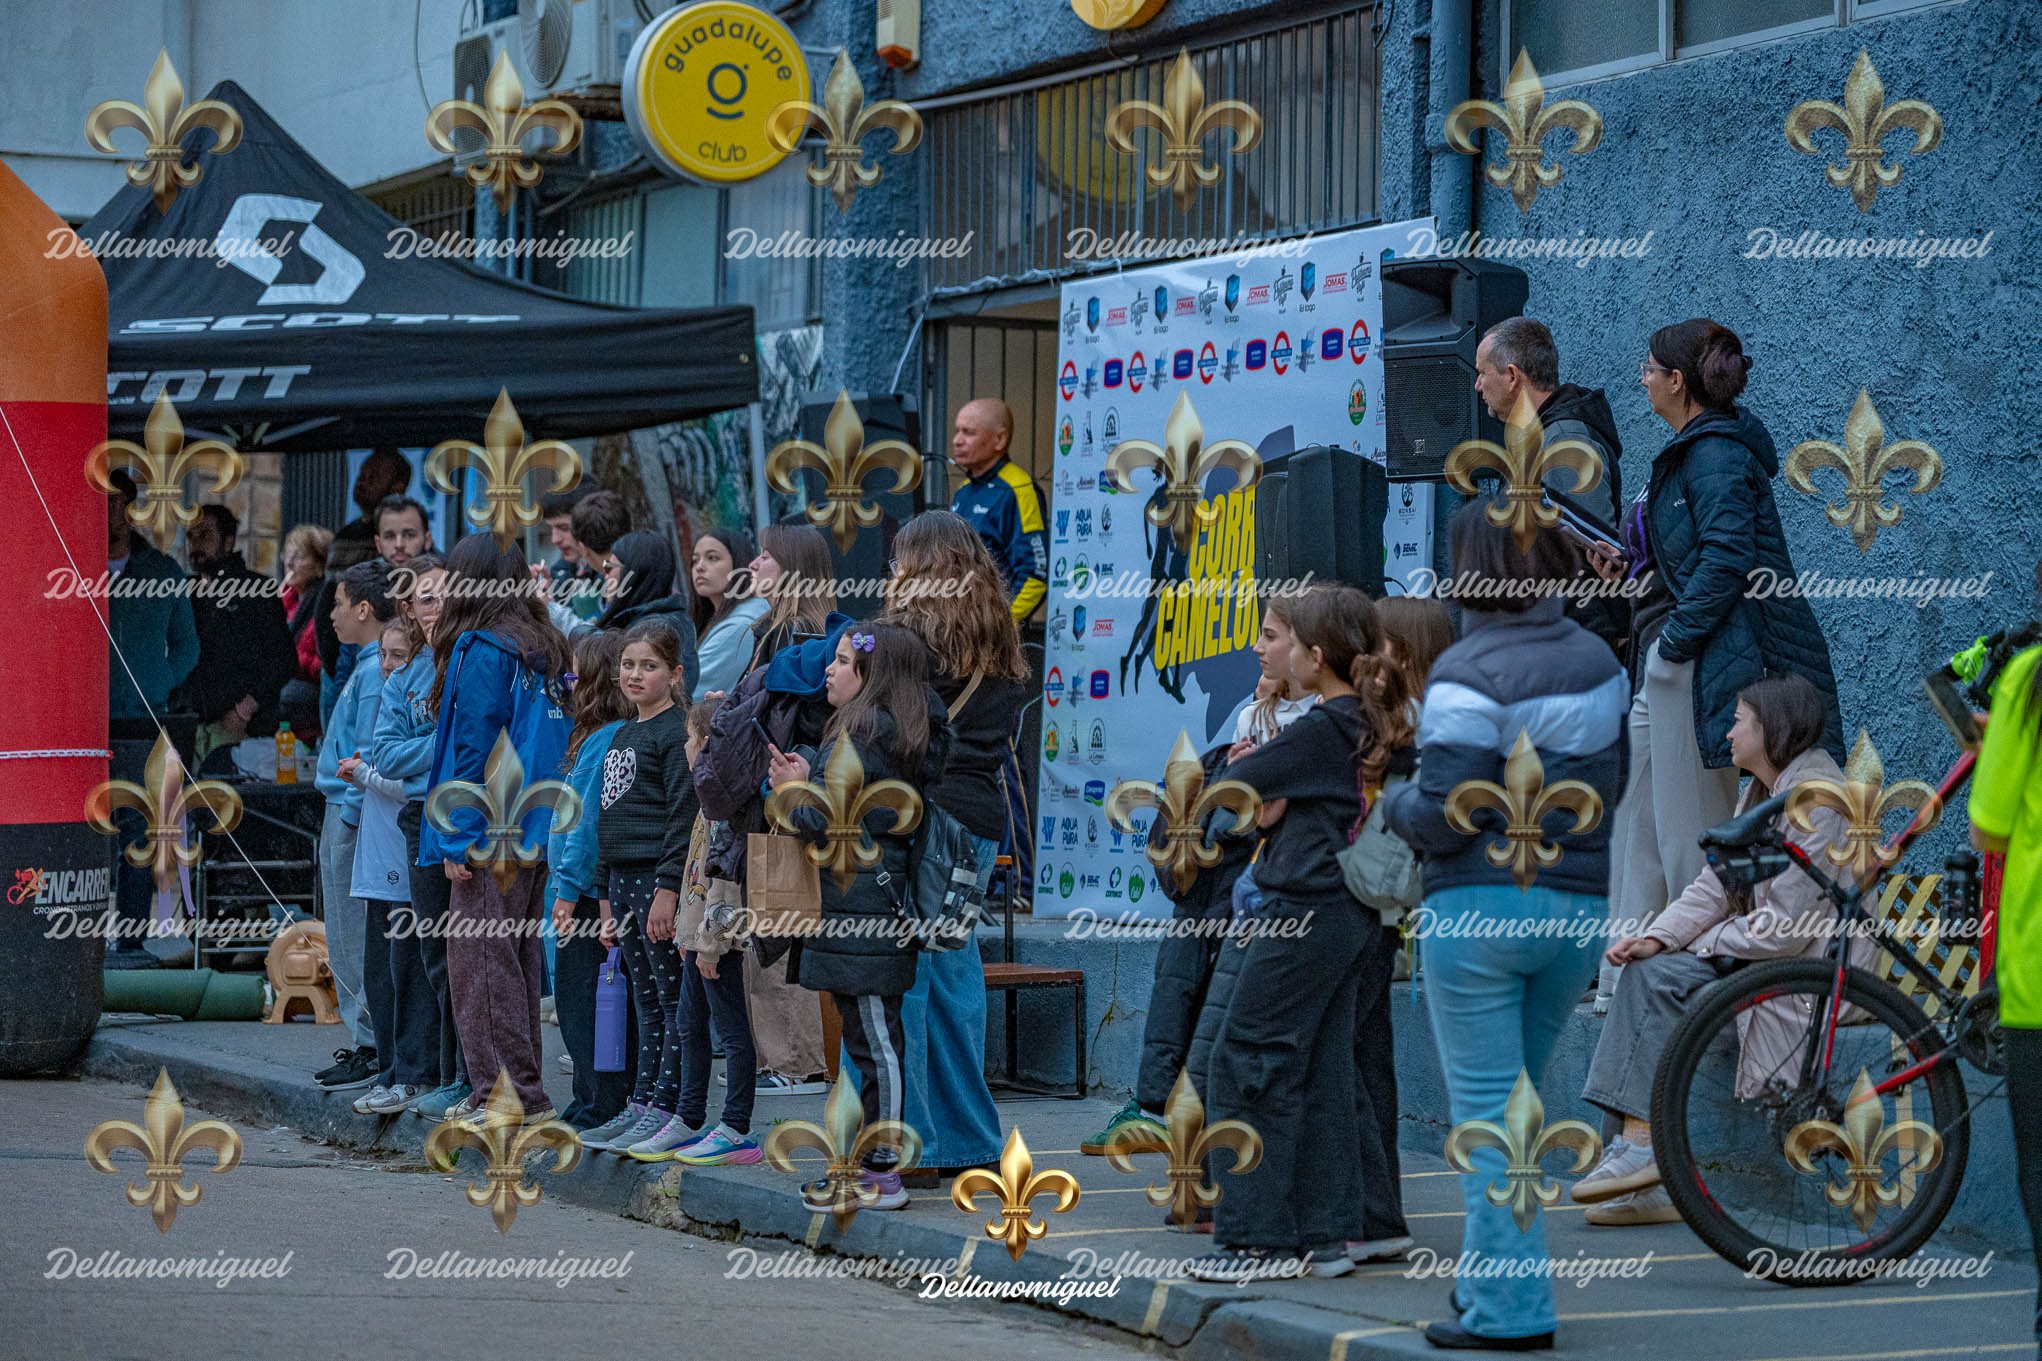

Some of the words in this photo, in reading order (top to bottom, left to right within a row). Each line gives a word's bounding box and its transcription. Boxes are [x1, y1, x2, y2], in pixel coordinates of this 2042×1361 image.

[664, 18, 793, 81] guadalupe
[698, 141, 748, 162] club
[120, 313, 521, 334] SCOTT
[107, 365, 312, 405] COTT
[1188, 485, 1256, 578] CORR
[1061, 817, 1079, 831] AQUA
[1062, 831, 1079, 845] PURA
